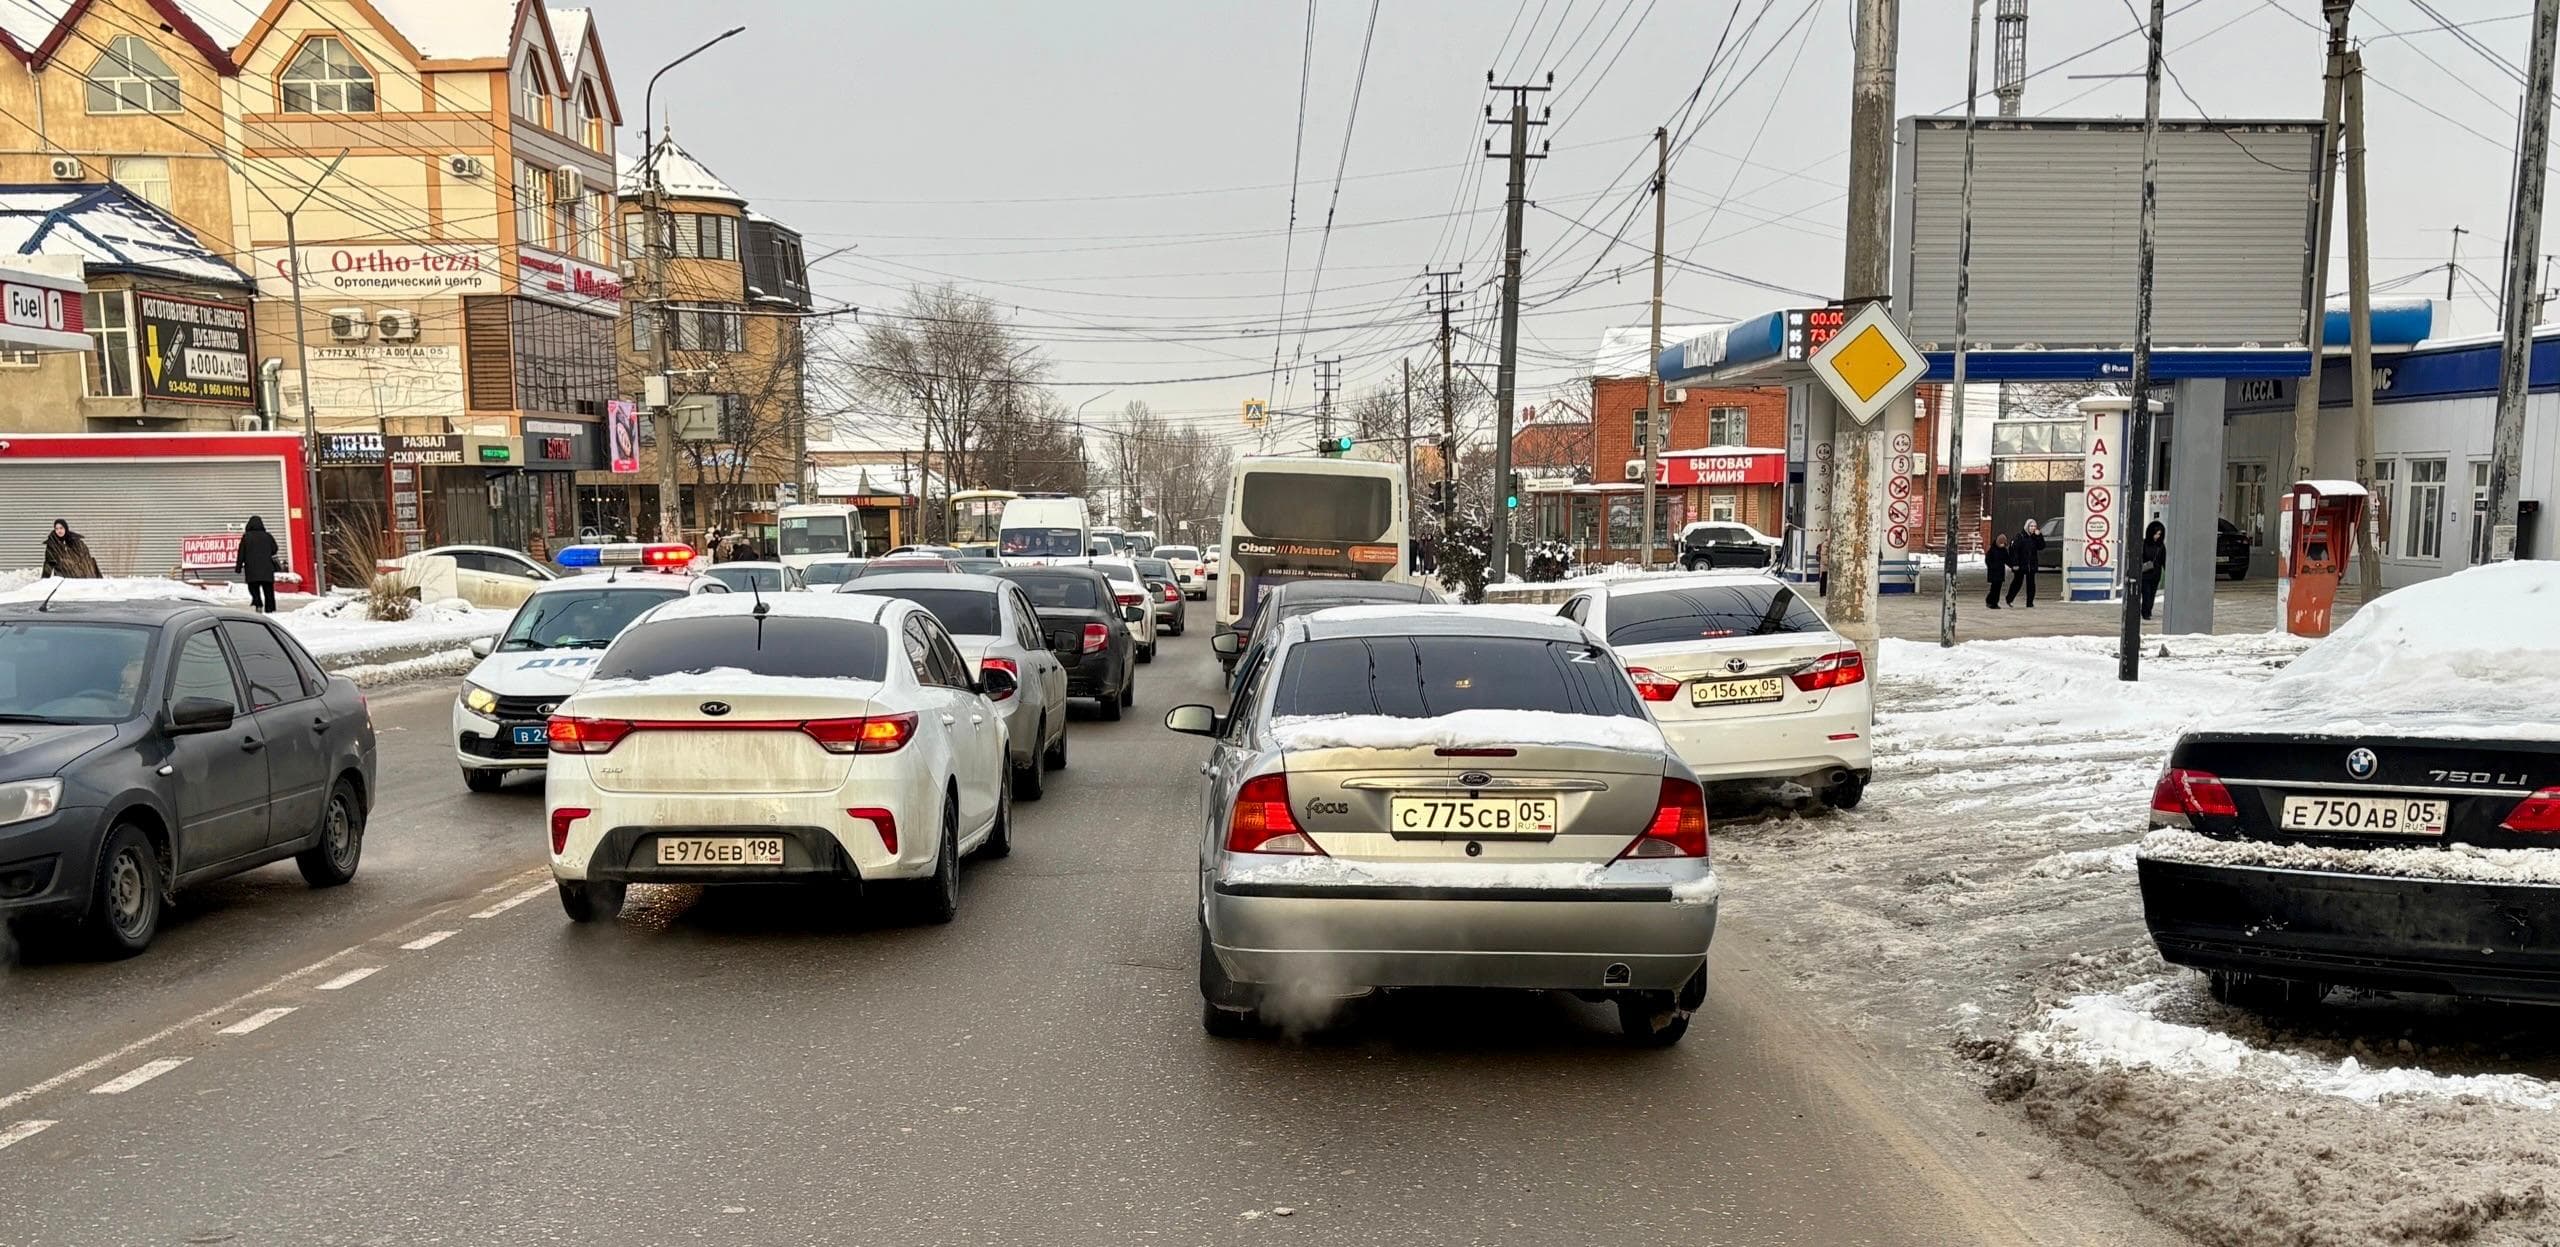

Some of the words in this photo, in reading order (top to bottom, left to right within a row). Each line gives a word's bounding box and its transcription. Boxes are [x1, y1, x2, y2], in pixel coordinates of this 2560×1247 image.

[332, 249, 480, 272] Ortho-tezzi
[334, 276, 441, 288] Ортопедический
[445, 277, 482, 288] центр
[13, 291, 41, 318] Fuel
[53, 298, 60, 322] 1
[142, 298, 199, 323] ИЗГОТОВЛЕНИЕ
[193, 327, 239, 350] ДУБЛИКАТОВ
[2238, 380, 2275, 402] КАССА
[403, 436, 446, 448] РАЗВАЛ
[1690, 457, 1753, 471] БЫТОВАЯ
[1697, 470, 1745, 483] ХИМИЯ
[185, 540, 225, 552] ПАРКОВКА
[226, 539, 240, 551] ДЛ
[185, 551, 227, 564] КЛИЕНТОВ
[516, 657, 598, 671] ДП
[1762, 679, 1778, 692] 05
[2429, 770, 2491, 784] 750
[1519, 803, 1546, 821] 05
[2407, 803, 2435, 822] 05
[748, 840, 777, 855] 198
